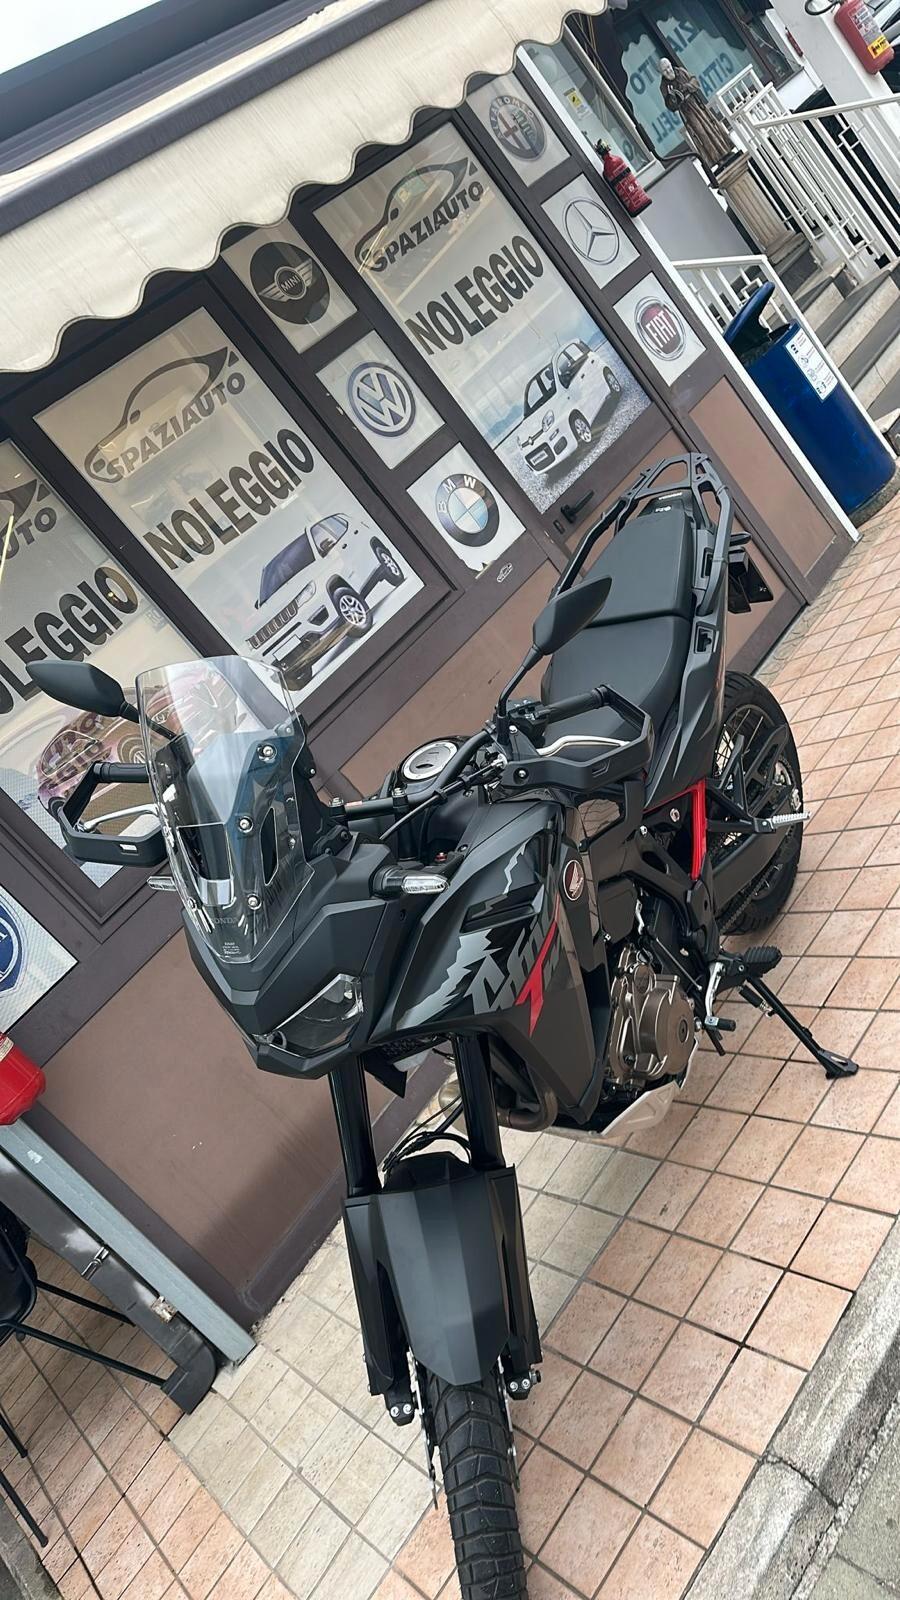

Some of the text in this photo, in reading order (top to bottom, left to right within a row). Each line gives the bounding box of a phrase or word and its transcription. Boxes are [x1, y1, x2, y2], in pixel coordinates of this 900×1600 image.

[371, 181, 484, 272] SPAZIAUTO
[281, 275, 301, 291] MINI
[404, 235, 544, 356] NOLEGGIO
[645, 310, 676, 348] FIAT
[106, 372, 246, 478] SPAZIAUTO
[142, 428, 315, 570] NOLEGGIO
[438, 475, 477, 514] BMW
